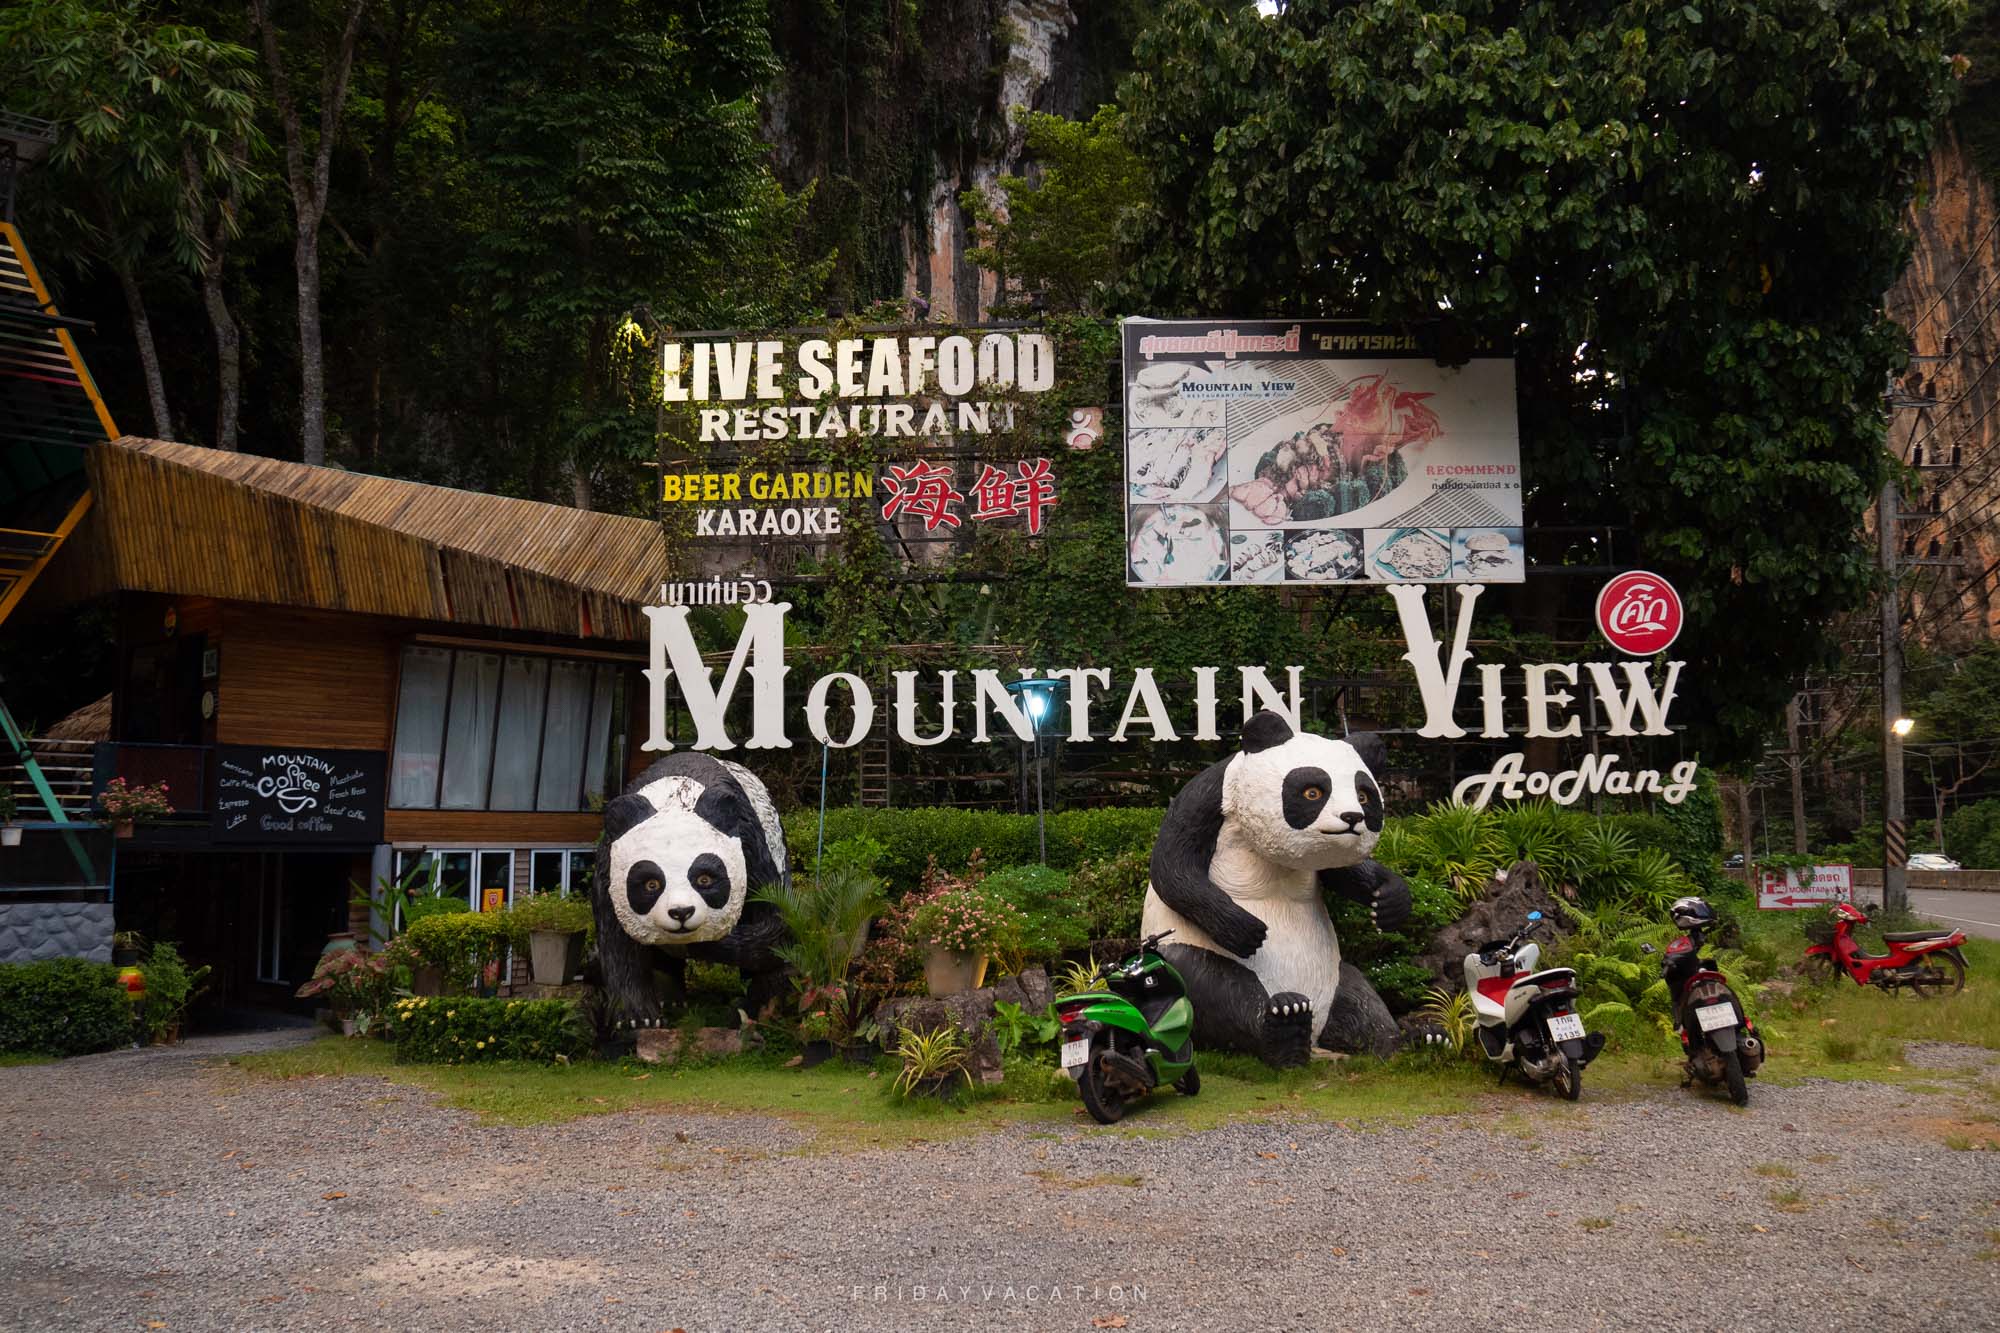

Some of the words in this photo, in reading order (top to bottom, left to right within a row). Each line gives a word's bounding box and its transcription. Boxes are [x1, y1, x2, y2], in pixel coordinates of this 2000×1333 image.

[663, 341, 784, 401] LIVE
[798, 333, 1055, 399] SEAFOOD
[1182, 382, 1253, 392] MOUNTAIN
[1262, 381, 1296, 391] VIEW
[1426, 464, 1517, 475] RECOMMEND
[663, 474, 741, 502] BEER
[749, 471, 874, 499] GARDEN
[880, 457, 1057, 536] 海鲜
[696, 508, 841, 536] KARAOKE
[640, 601, 1306, 751] MOUNTAIN
[1385, 584, 1687, 738] VIEW
[262, 755, 335, 775] MOUNTAIN
[1557, 1030, 1581, 1040] 2135
